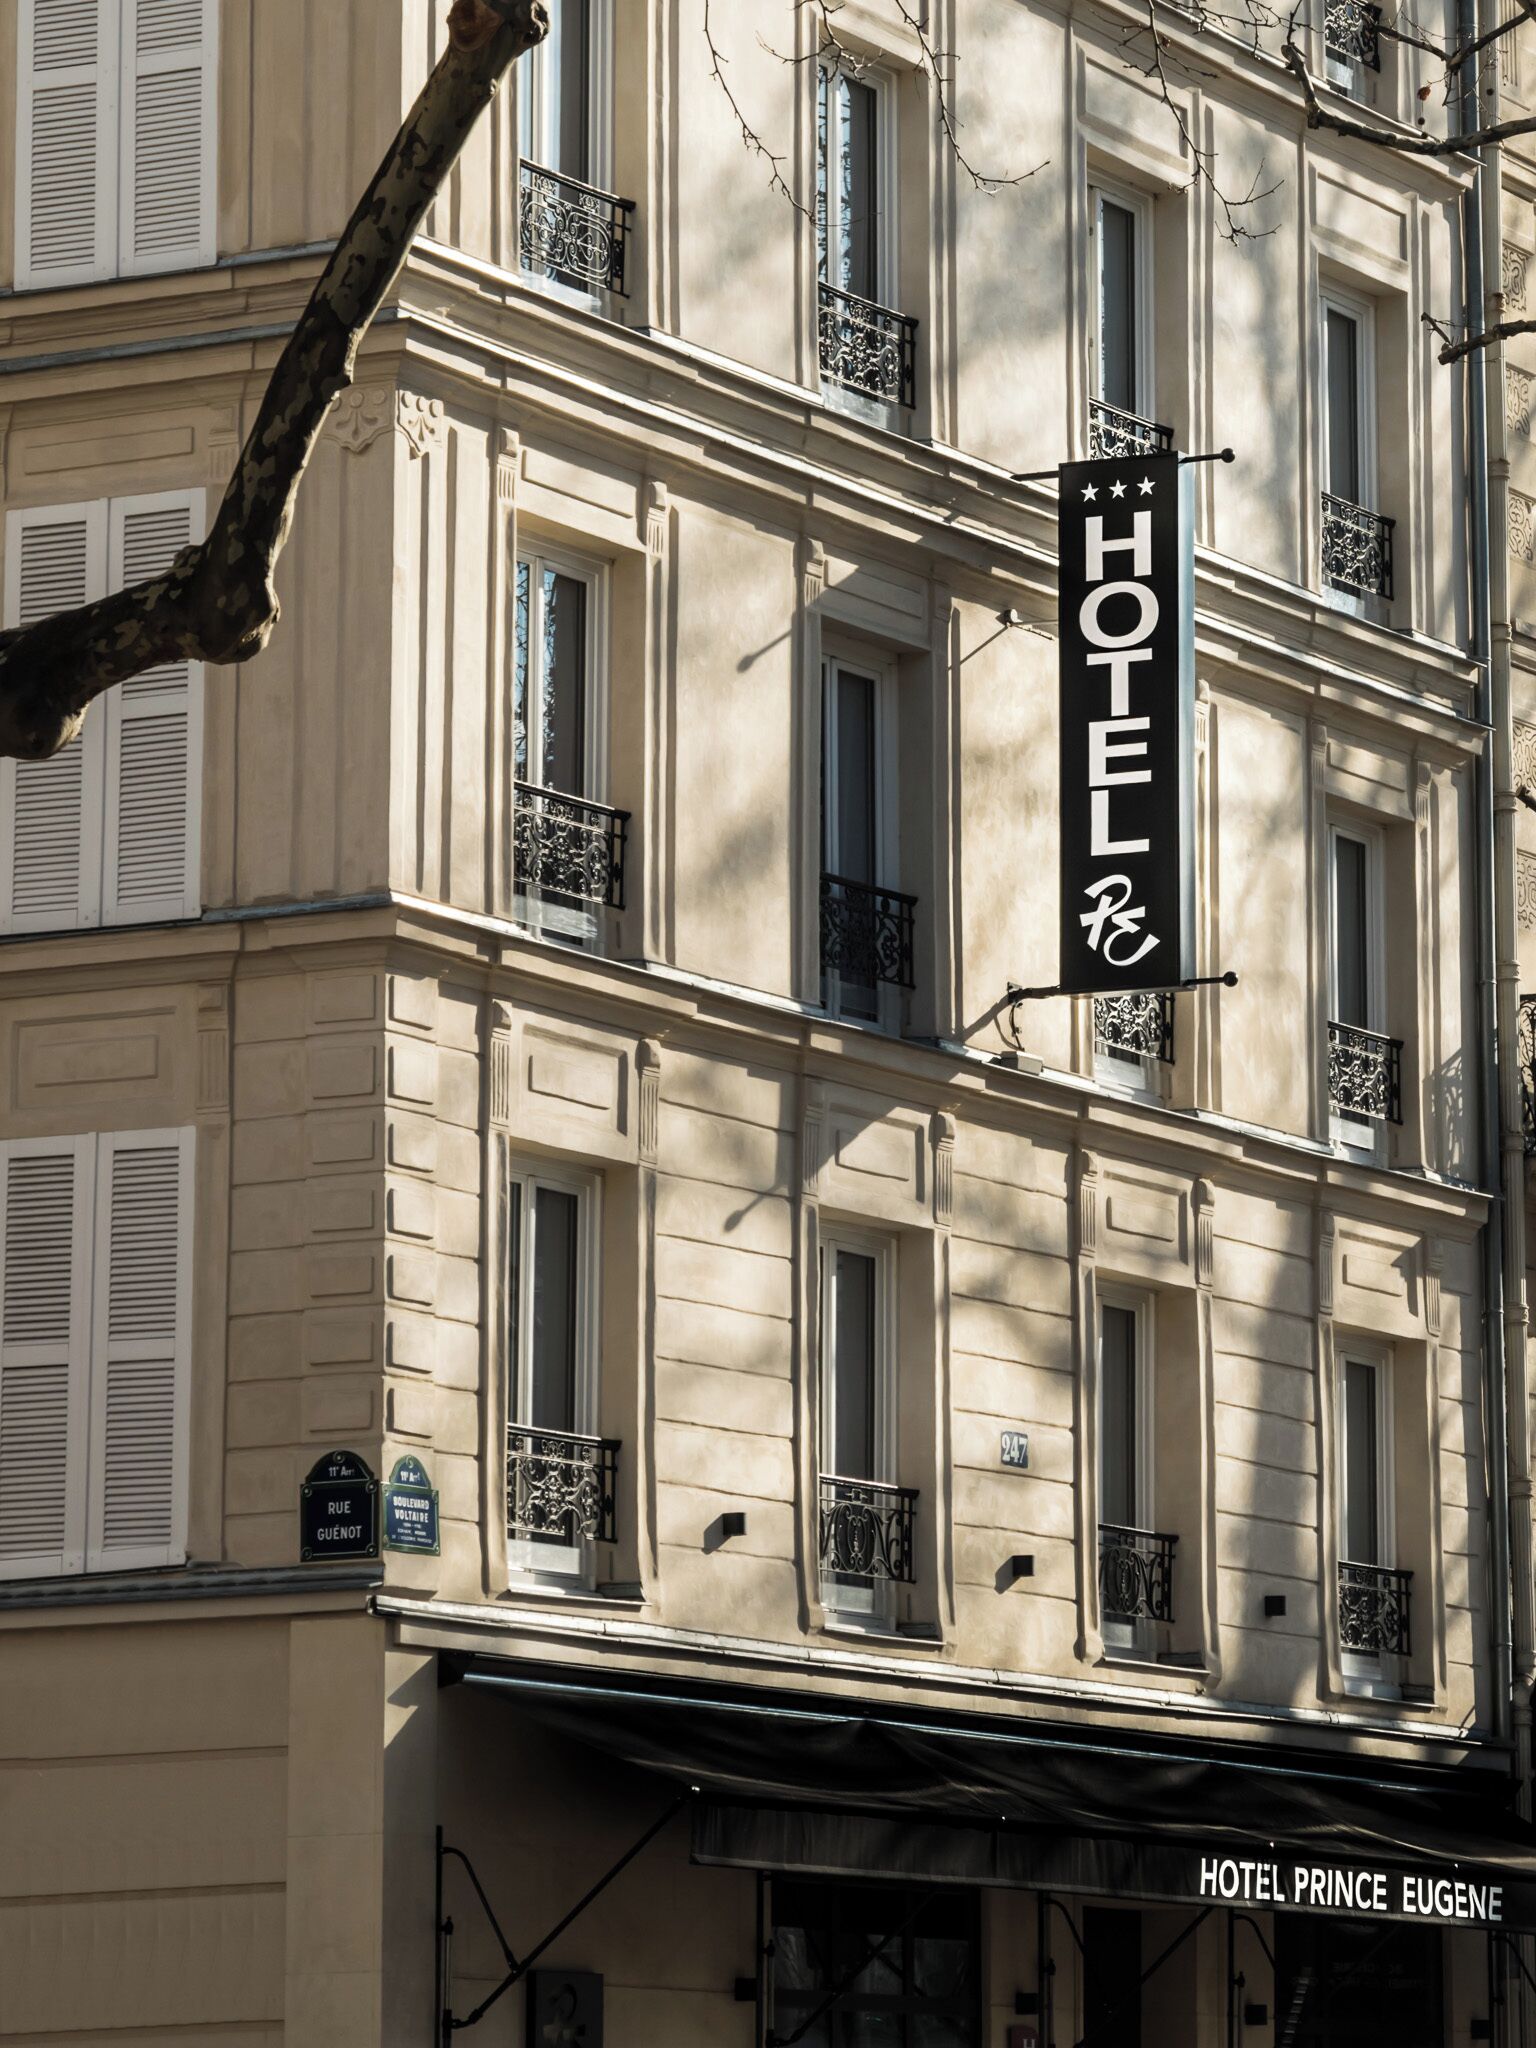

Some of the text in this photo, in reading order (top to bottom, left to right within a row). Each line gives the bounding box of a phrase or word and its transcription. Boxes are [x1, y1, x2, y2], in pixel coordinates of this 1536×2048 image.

[1079, 511, 1160, 857] HOTEL
[1001, 1433, 1028, 1464] 247
[328, 1501, 351, 1515] RUE
[393, 1496, 430, 1511] BOULEVARD
[394, 1508, 429, 1523] VOLTAIRE
[317, 1524, 362, 1541] GUÉNOT
[1200, 1857, 1503, 1921] HOTEL PRINCE EUGENE
